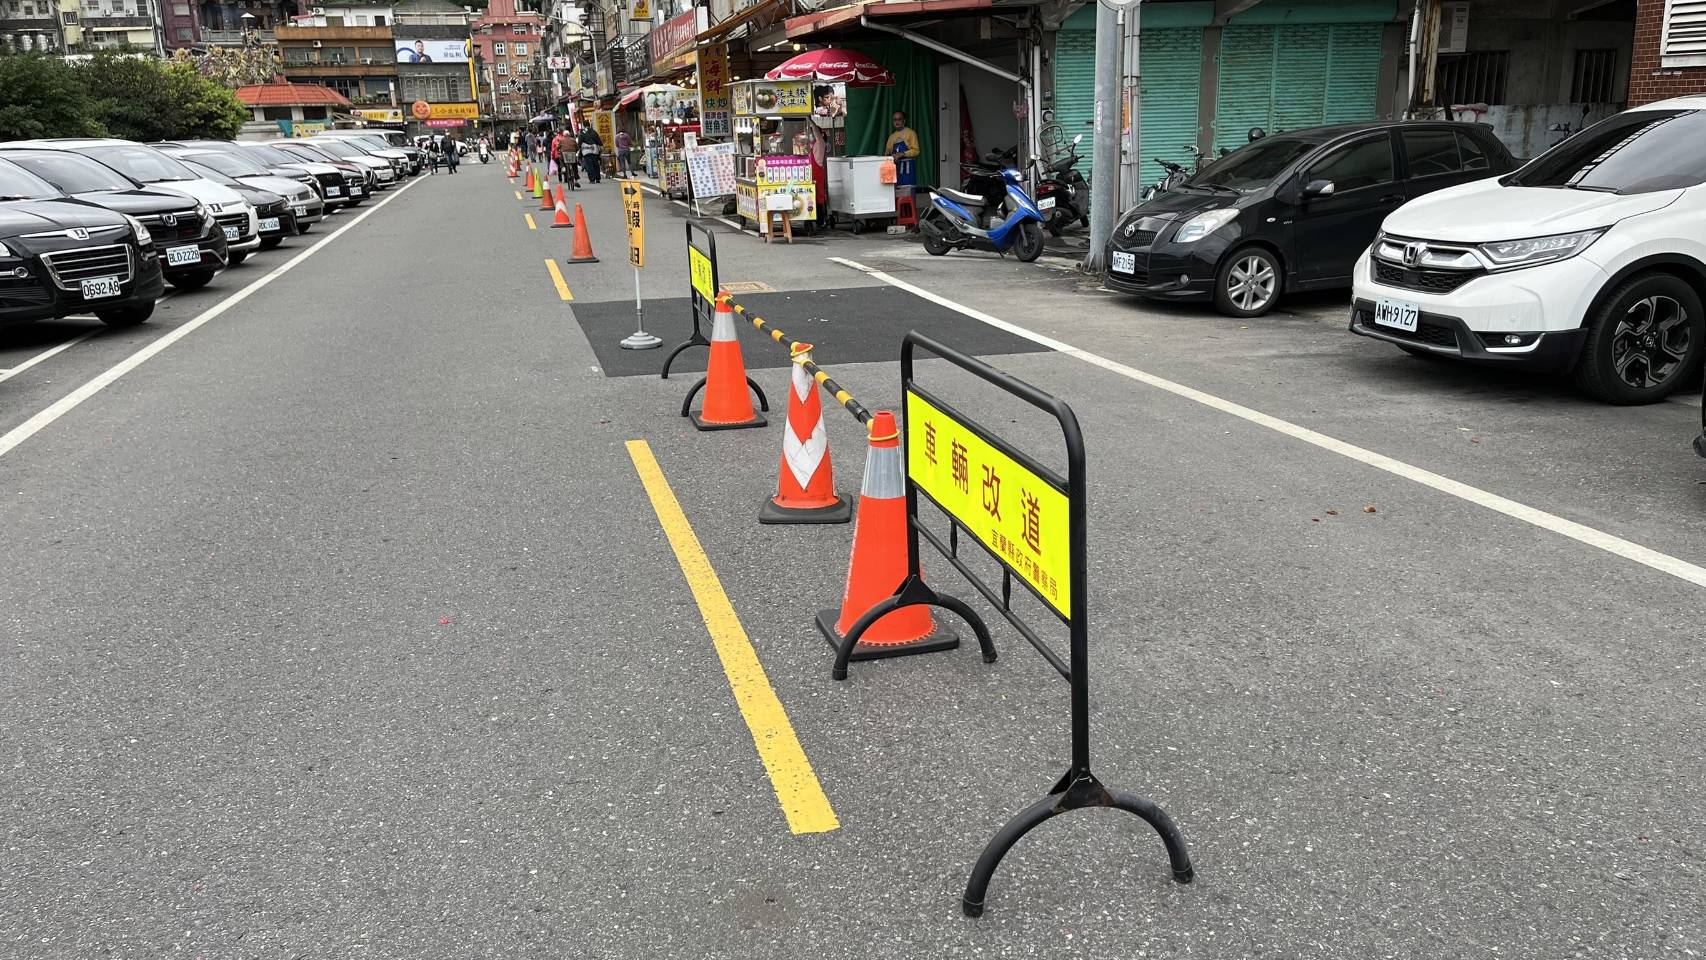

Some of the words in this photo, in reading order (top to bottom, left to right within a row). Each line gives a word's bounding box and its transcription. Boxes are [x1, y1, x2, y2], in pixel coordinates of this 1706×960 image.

[704, 60, 722, 95] 海鮮
[705, 98, 728, 108] 快炒
[776, 98, 807, 106] 冰淇淋
[705, 119, 729, 134] 鮮魚湯
[924, 420, 1042, 556] 車輛改道
[991, 529, 1058, 601] 宜蘭縣政府警察局
